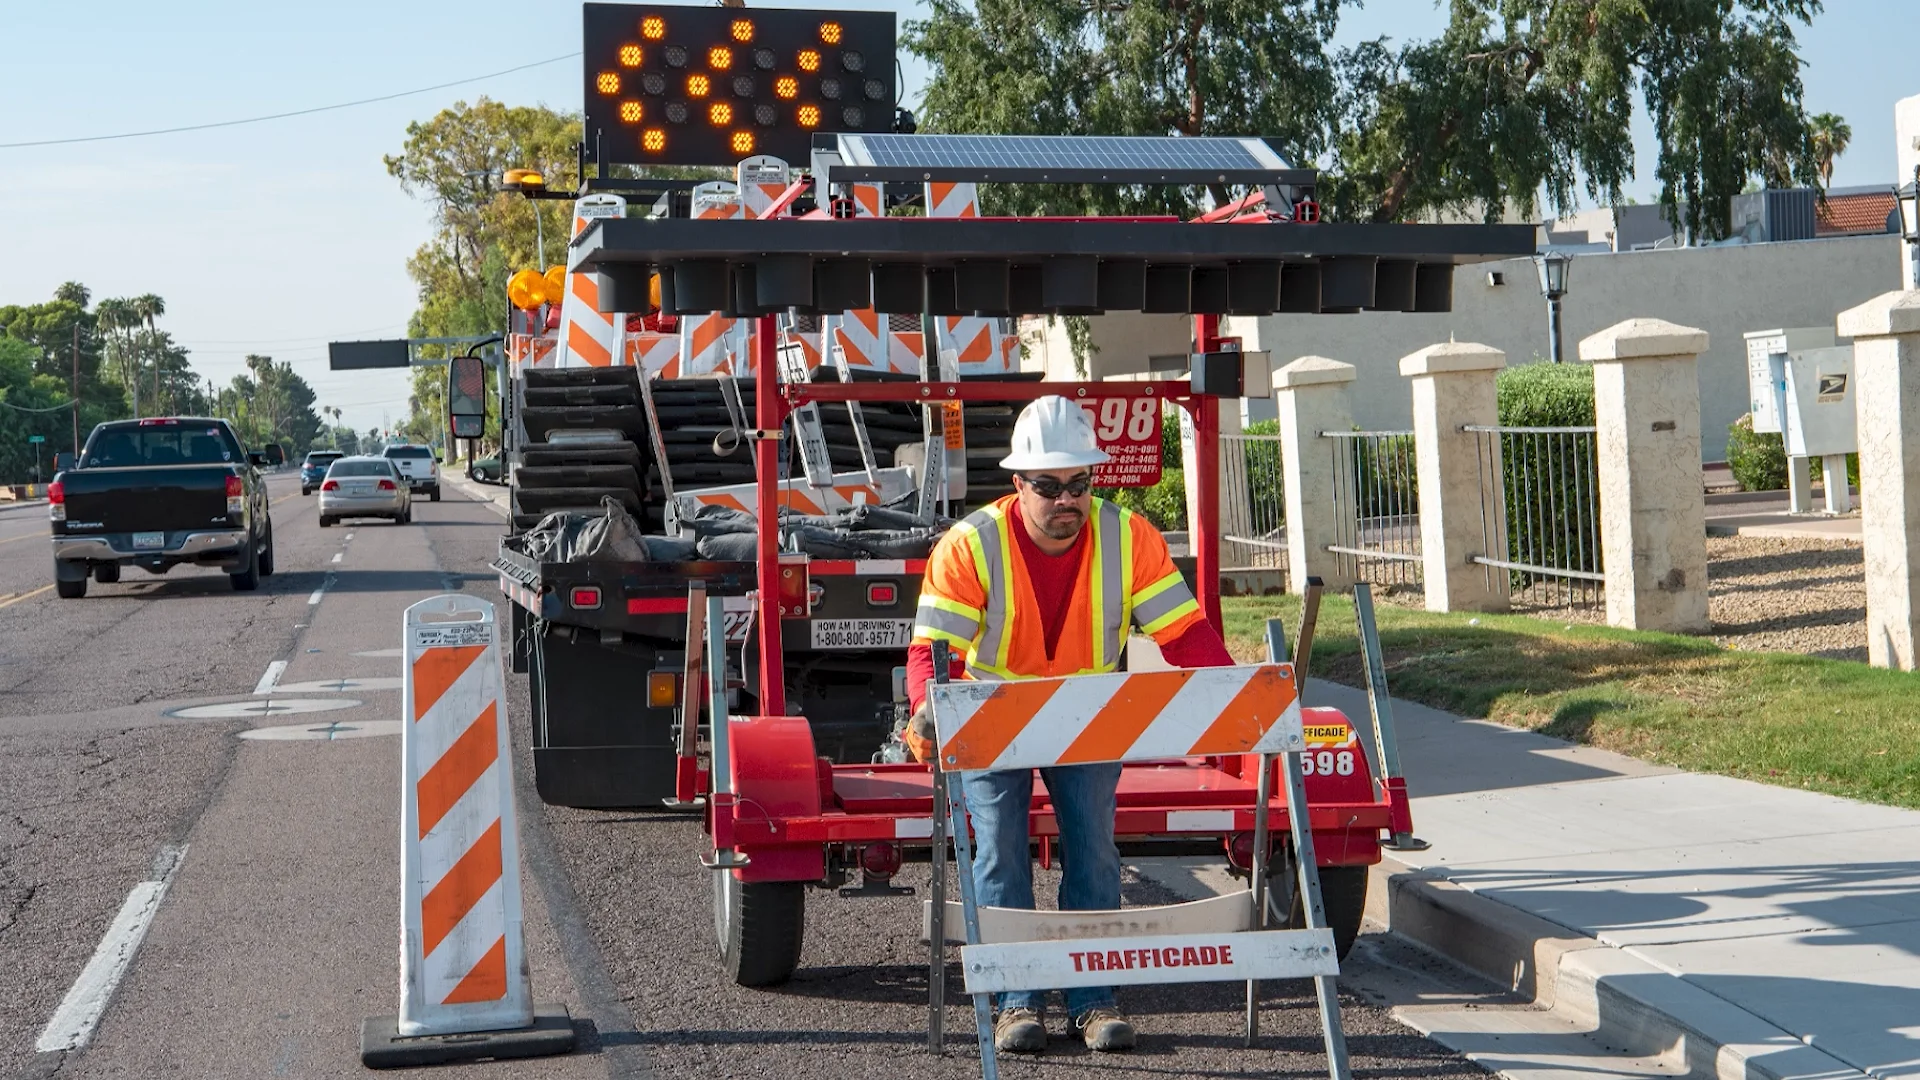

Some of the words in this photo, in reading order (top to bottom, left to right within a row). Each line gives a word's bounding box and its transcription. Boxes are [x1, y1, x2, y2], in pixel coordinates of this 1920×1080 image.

[703, 612, 755, 641] 22
[818, 621, 837, 631] HOW
[839, 621, 851, 631] AM
[858, 621, 896, 631] DRIVING?
[816, 632, 896, 646] 1-800-800-9577
[1303, 727, 1345, 738] FFICADE
[1299, 750, 1355, 777] 598
[1069, 944, 1234, 973] TRAFFICADE
